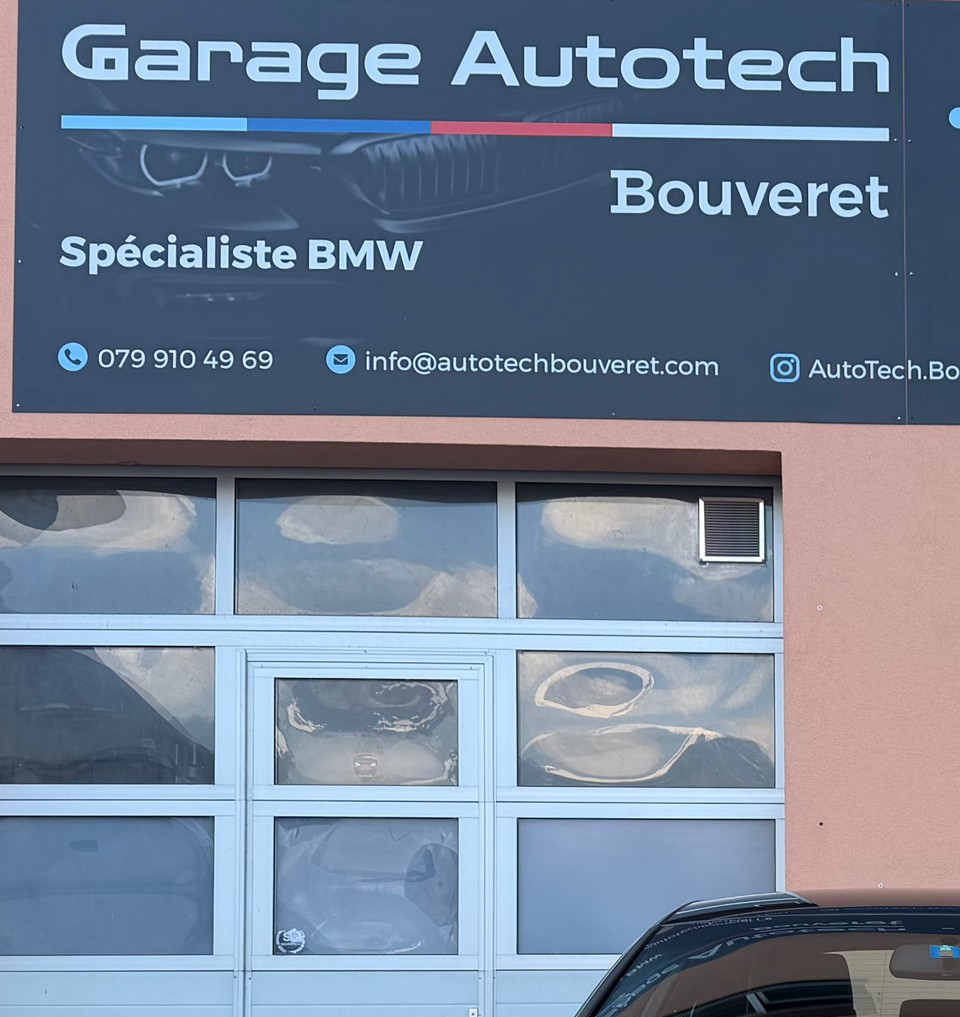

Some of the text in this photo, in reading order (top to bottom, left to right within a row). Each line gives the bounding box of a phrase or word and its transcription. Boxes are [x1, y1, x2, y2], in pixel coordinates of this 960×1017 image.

[62, 24, 889, 99] Garage Autotech
[611, 170, 888, 218] Bouveret
[60, 234, 423, 275] Spécialiste BMW
[99, 349, 273, 369] 079 910 49 69
[366, 351, 718, 375] info@autotechbouveret.com
